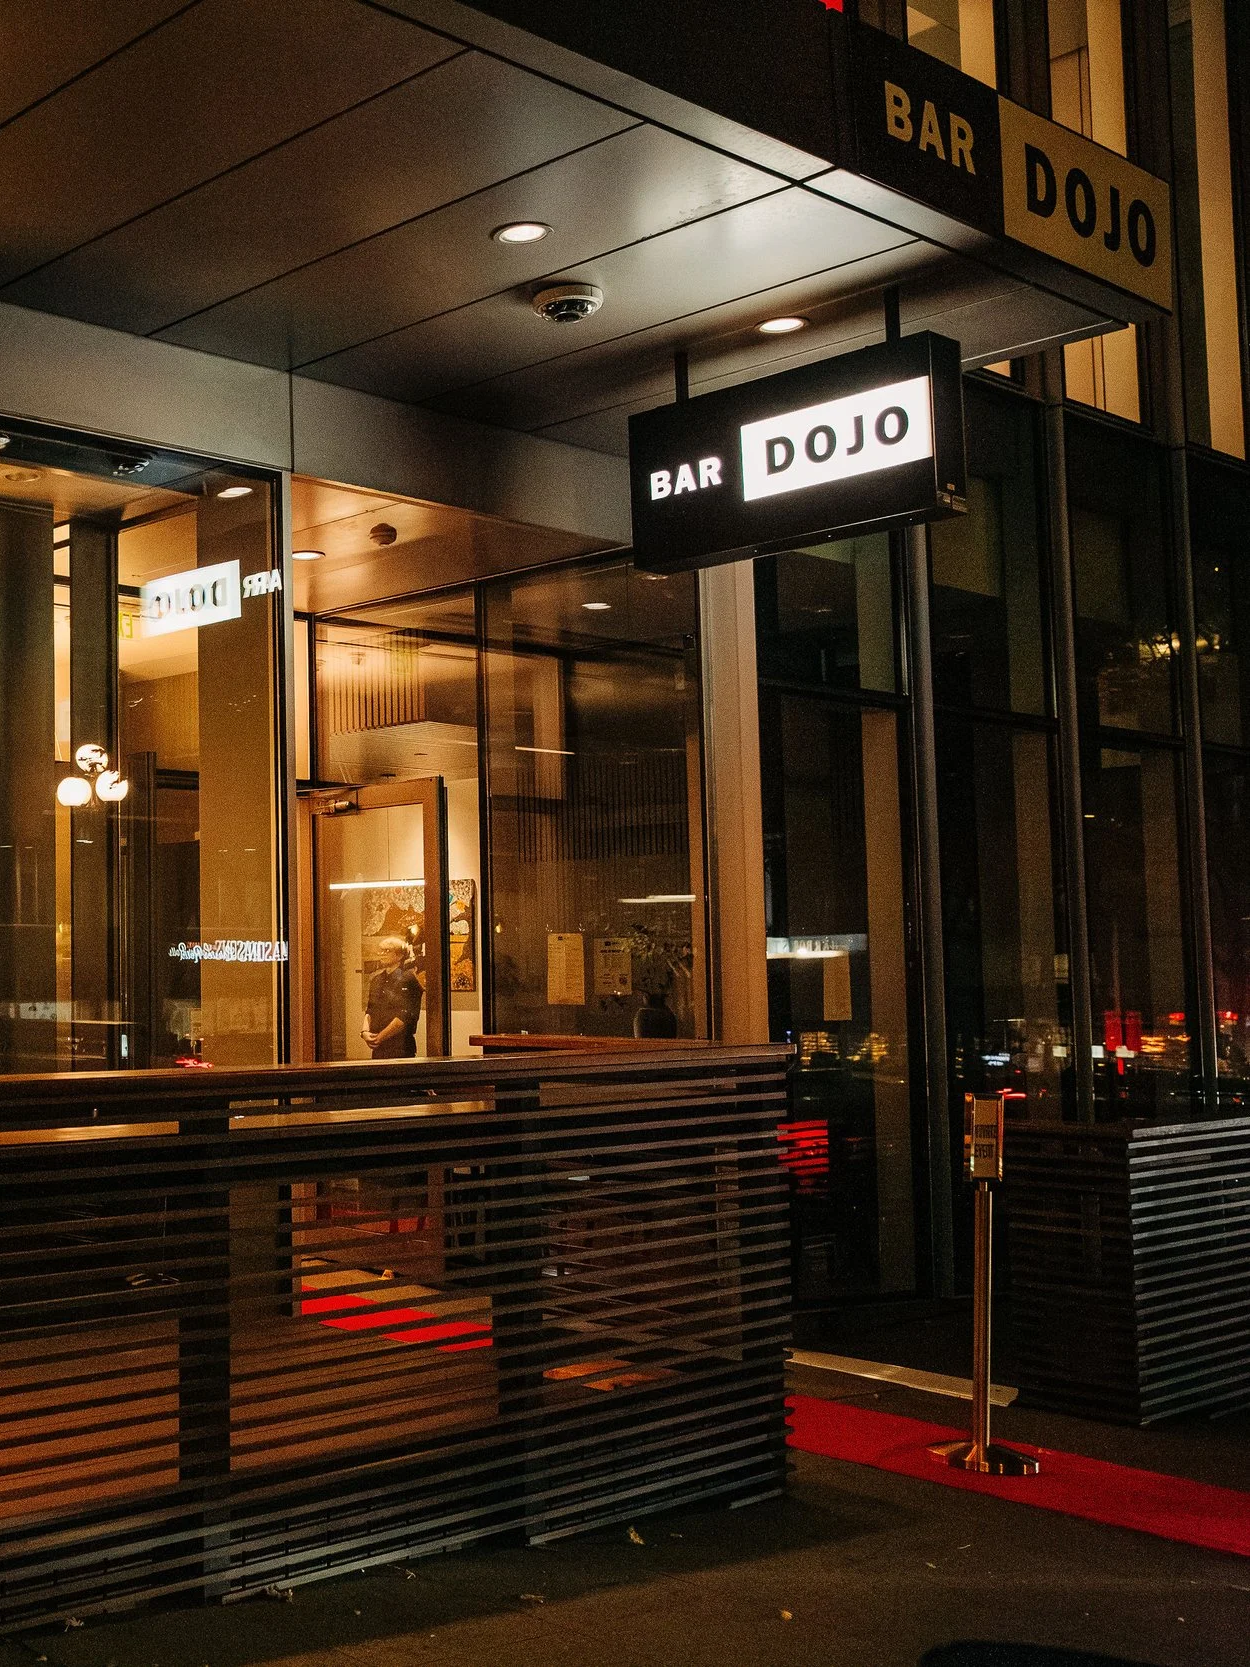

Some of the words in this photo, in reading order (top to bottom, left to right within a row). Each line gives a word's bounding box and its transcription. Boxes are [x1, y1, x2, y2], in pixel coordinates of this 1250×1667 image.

[884, 80, 976, 176] BAR
[1024, 142, 1157, 268] DOJO
[650, 457, 723, 501] BAR
[764, 405, 910, 476] DOJO
